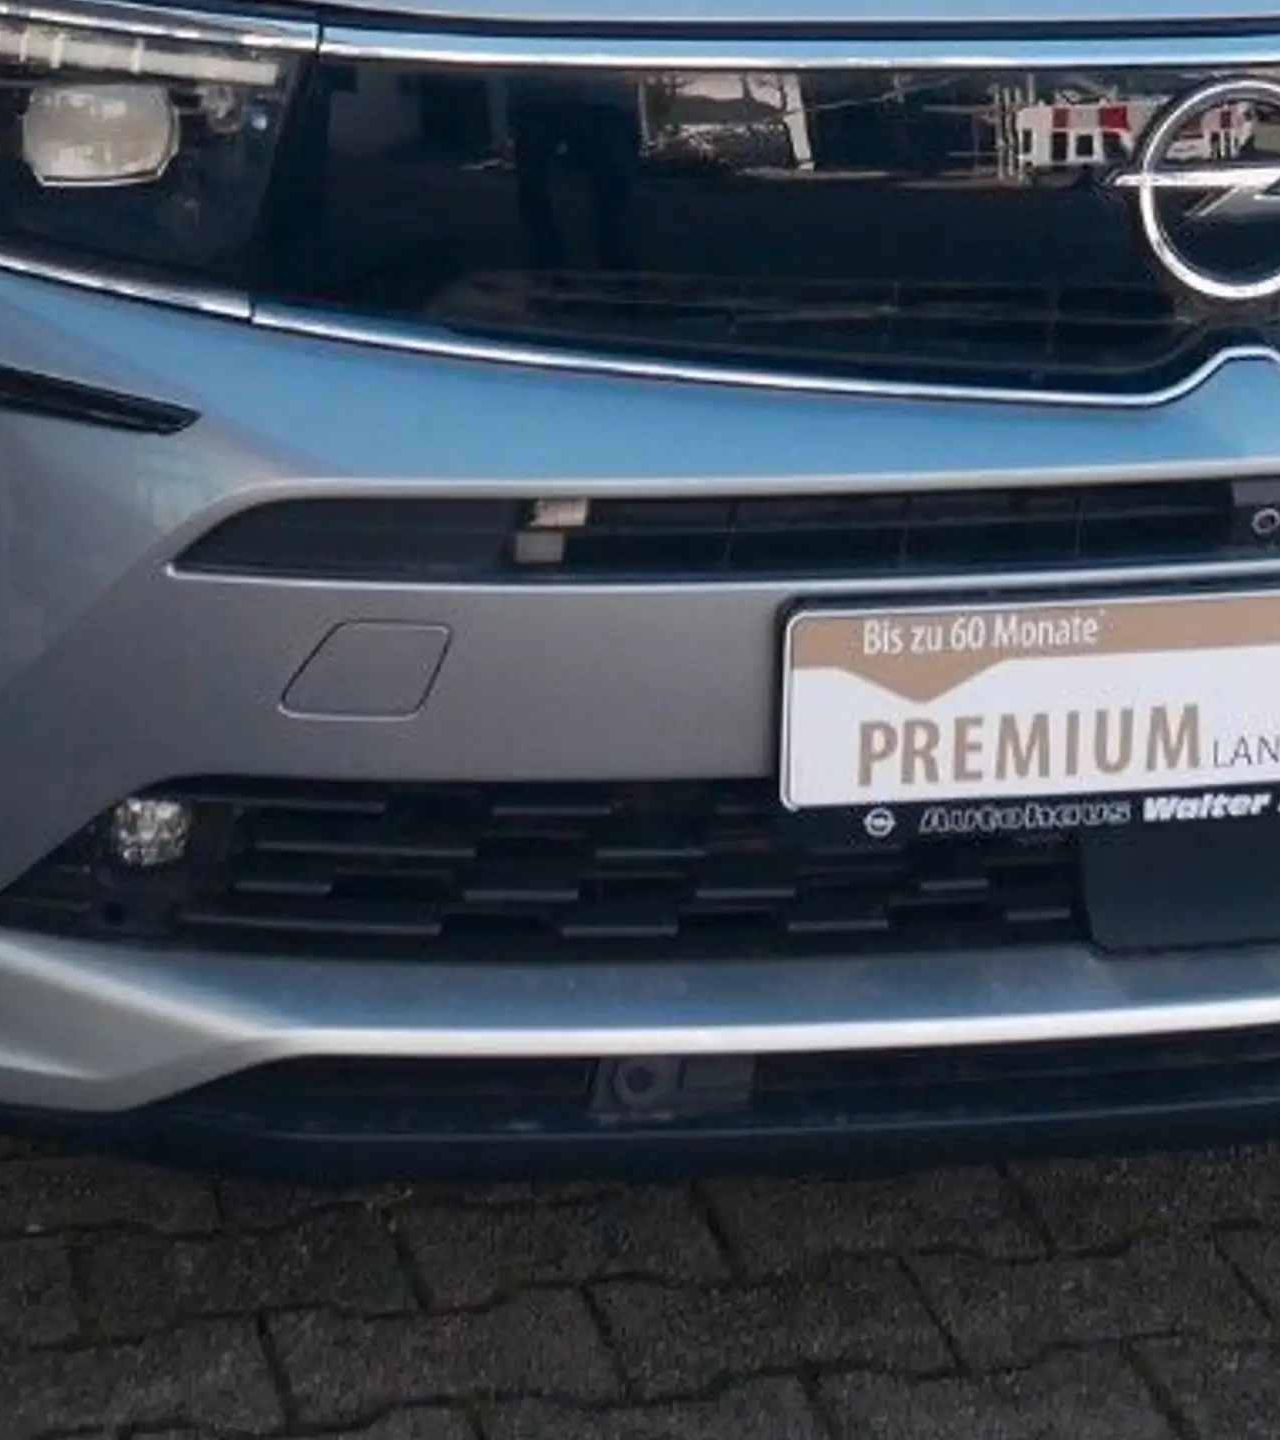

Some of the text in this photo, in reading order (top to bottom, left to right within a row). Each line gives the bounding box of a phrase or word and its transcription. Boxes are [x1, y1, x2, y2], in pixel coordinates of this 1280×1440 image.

[863, 619, 904, 655] Bis
[910, 624, 943, 653] zu
[950, 615, 986, 651] 60
[857, 703, 1201, 787] PREMIUM
[919, 802, 1132, 833] Autohaus
[1143, 792, 1272, 821] Walter
